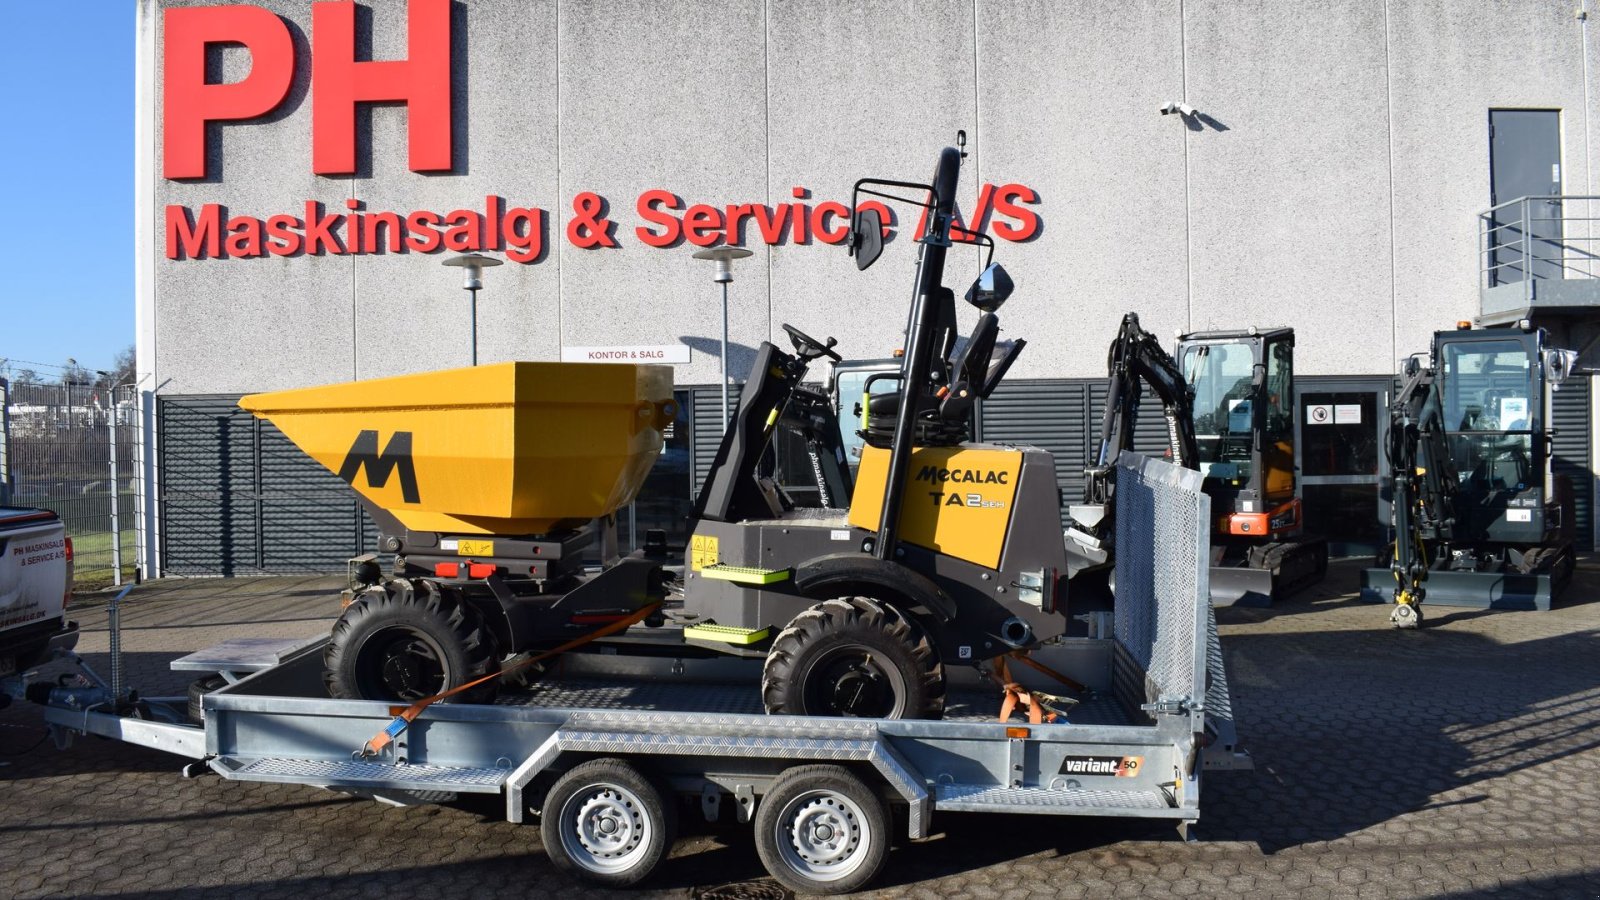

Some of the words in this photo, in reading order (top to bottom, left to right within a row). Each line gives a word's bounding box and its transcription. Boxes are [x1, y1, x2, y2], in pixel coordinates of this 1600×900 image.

[163, 0, 452, 180] PH
[165, 194, 543, 263] Maskinsalg
[566, 191, 615, 249] &
[588, 351, 628, 360] KONTOR
[630, 350, 637, 359] &
[639, 350, 665, 359] SALG
[13, 546, 24, 556] PH
[25, 539, 64, 553] MASKINSALG
[27, 552, 54, 566] SERVICE
[1066, 757, 1118, 774] variant
[1124, 760, 1138, 769] 50
